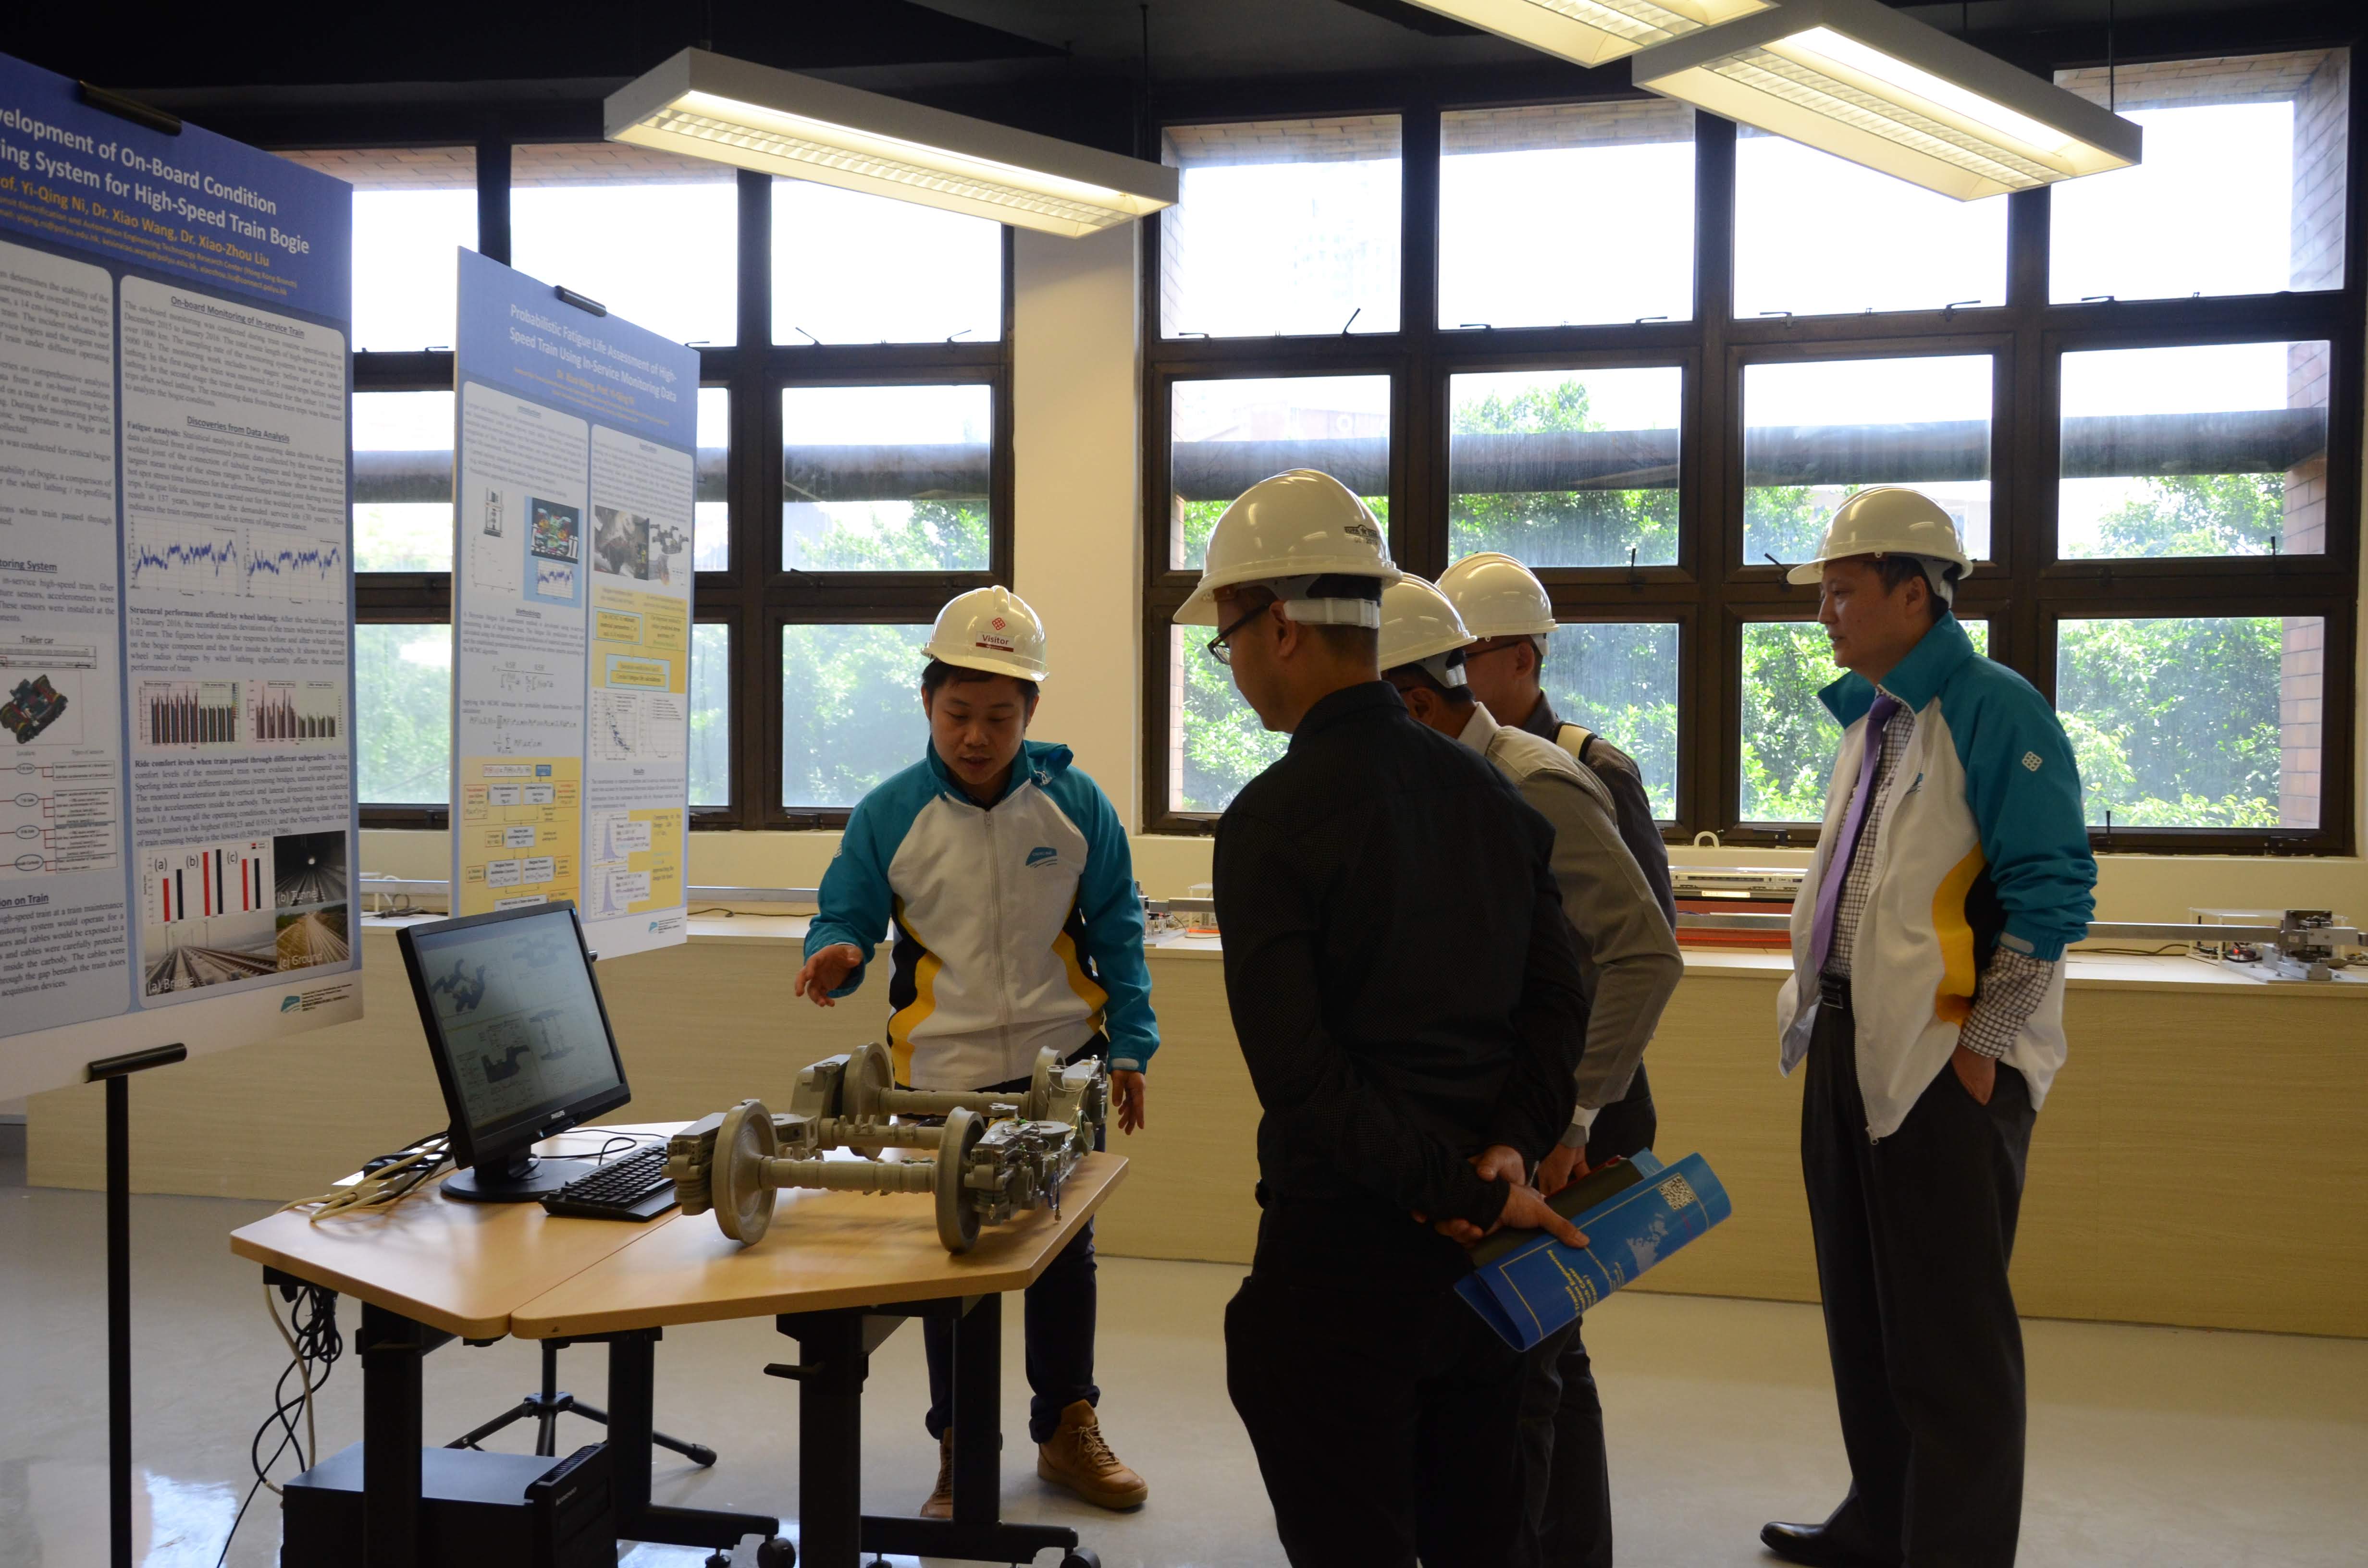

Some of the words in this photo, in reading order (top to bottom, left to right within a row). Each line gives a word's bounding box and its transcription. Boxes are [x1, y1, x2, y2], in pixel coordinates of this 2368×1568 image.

[98, 142, 117, 161] of
[121, 147, 199, 190] On-Board
[204, 176, 276, 215] Condition
[35, 151, 100, 188] System
[105, 172, 130, 197] for
[135, 183, 225, 228] High-Speed
[229, 213, 266, 241] Train
[270, 227, 309, 254] Bogie
[21, 181, 69, 210] Yi-Qing
[71, 196, 89, 215] Ni,
[92, 202, 109, 219] Dr.
[112, 208, 139, 228] Xiao
[141, 218, 177, 242] Wang,
[180, 229, 196, 245] Dr.
[198, 235, 252, 262] Xiao-Zhou
[254, 252, 270, 267] Liu
[171, 295, 205, 312] On-board
[207, 305, 246, 323] Monitoring
[247, 316, 255, 324] of
[256, 318, 287, 333] In-service
[289, 326, 305, 337] Train
[510, 304, 562, 337] Probabilistic
[563, 325, 592, 349] Fatigue
[592, 338, 607, 355] Life
[607, 344, 650, 372] Assessment
[650, 363, 658, 375] of
[659, 366, 677, 383] High-
[509, 326, 536, 348] Speed
[537, 337, 558, 357] Train
[559, 346, 582, 369] Using
[583, 355, 620, 381] In-Service
[620, 370, 660, 399] Monitoring
[660, 386, 677, 403] Data
[127, 420, 152, 433] Fatigue
[153, 428, 181, 437] analysis:
[187, 416, 227, 430] Discoveries
[228, 423, 245, 433] from
[246, 427, 262, 437] Data
[263, 430, 290, 442] Analysis
[27, 560, 57, 571] System
[129, 606, 163, 615] Structural
[164, 609, 204, 617] performance
[205, 611, 229, 619] affected
[230, 612, 237, 621] by
[257, 614, 278, 623] lathing:
[21, 635, 43, 644] Trailer
[982, 634, 1009, 645] Visitor
[151, 759, 176, 767] comfort
[230, 757, 249, 766] passed
[250, 756, 272, 764] through
[298, 754, 326, 762] subgrades:
[155, 858, 167, 872] (a)
[186, 855, 198, 869] (b)
[227, 851, 238, 865] (c)
[14, 897, 26, 906] on
[27, 893, 49, 904] Train
[277, 891, 288, 904] (b)
[292, 952, 322, 965] Ground
[0, 985, 39, 997] acquisition
[40, 980, 67, 990] devices.
[148, 980, 161, 994] (a)
